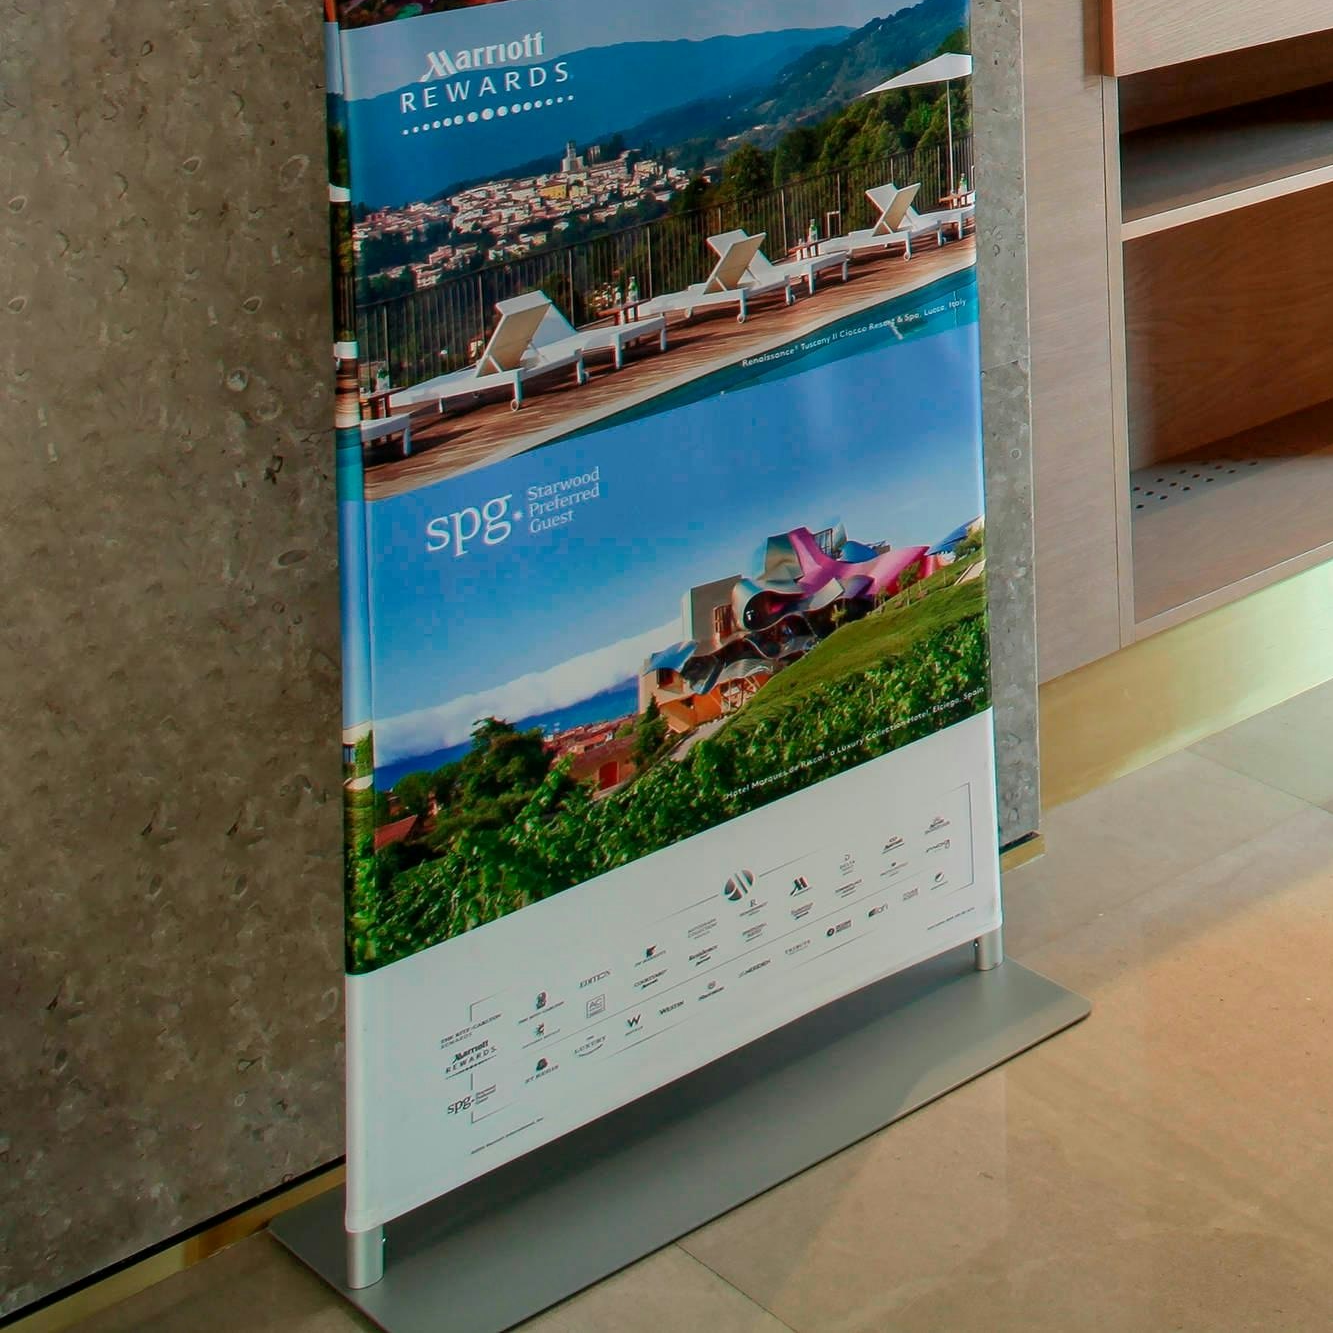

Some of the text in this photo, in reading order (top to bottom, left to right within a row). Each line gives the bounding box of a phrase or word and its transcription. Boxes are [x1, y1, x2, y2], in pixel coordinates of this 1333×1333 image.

[419, 31, 544, 82] Marriott
[401, 62, 569, 114] REWARDS
[801, 336, 831, 351] Tuscany
[839, 326, 868, 338] Ciocco
[527, 466, 600, 501] Starwood
[529, 482, 600, 518] Preferred
[529, 509, 575, 534] Guest
[726, 784, 750, 799] Hotel
[788, 764, 799, 773] de
[837, 738, 864, 755] Luxury
[865, 721, 905, 741] Collection
[963, 687, 984, 700] Spain
